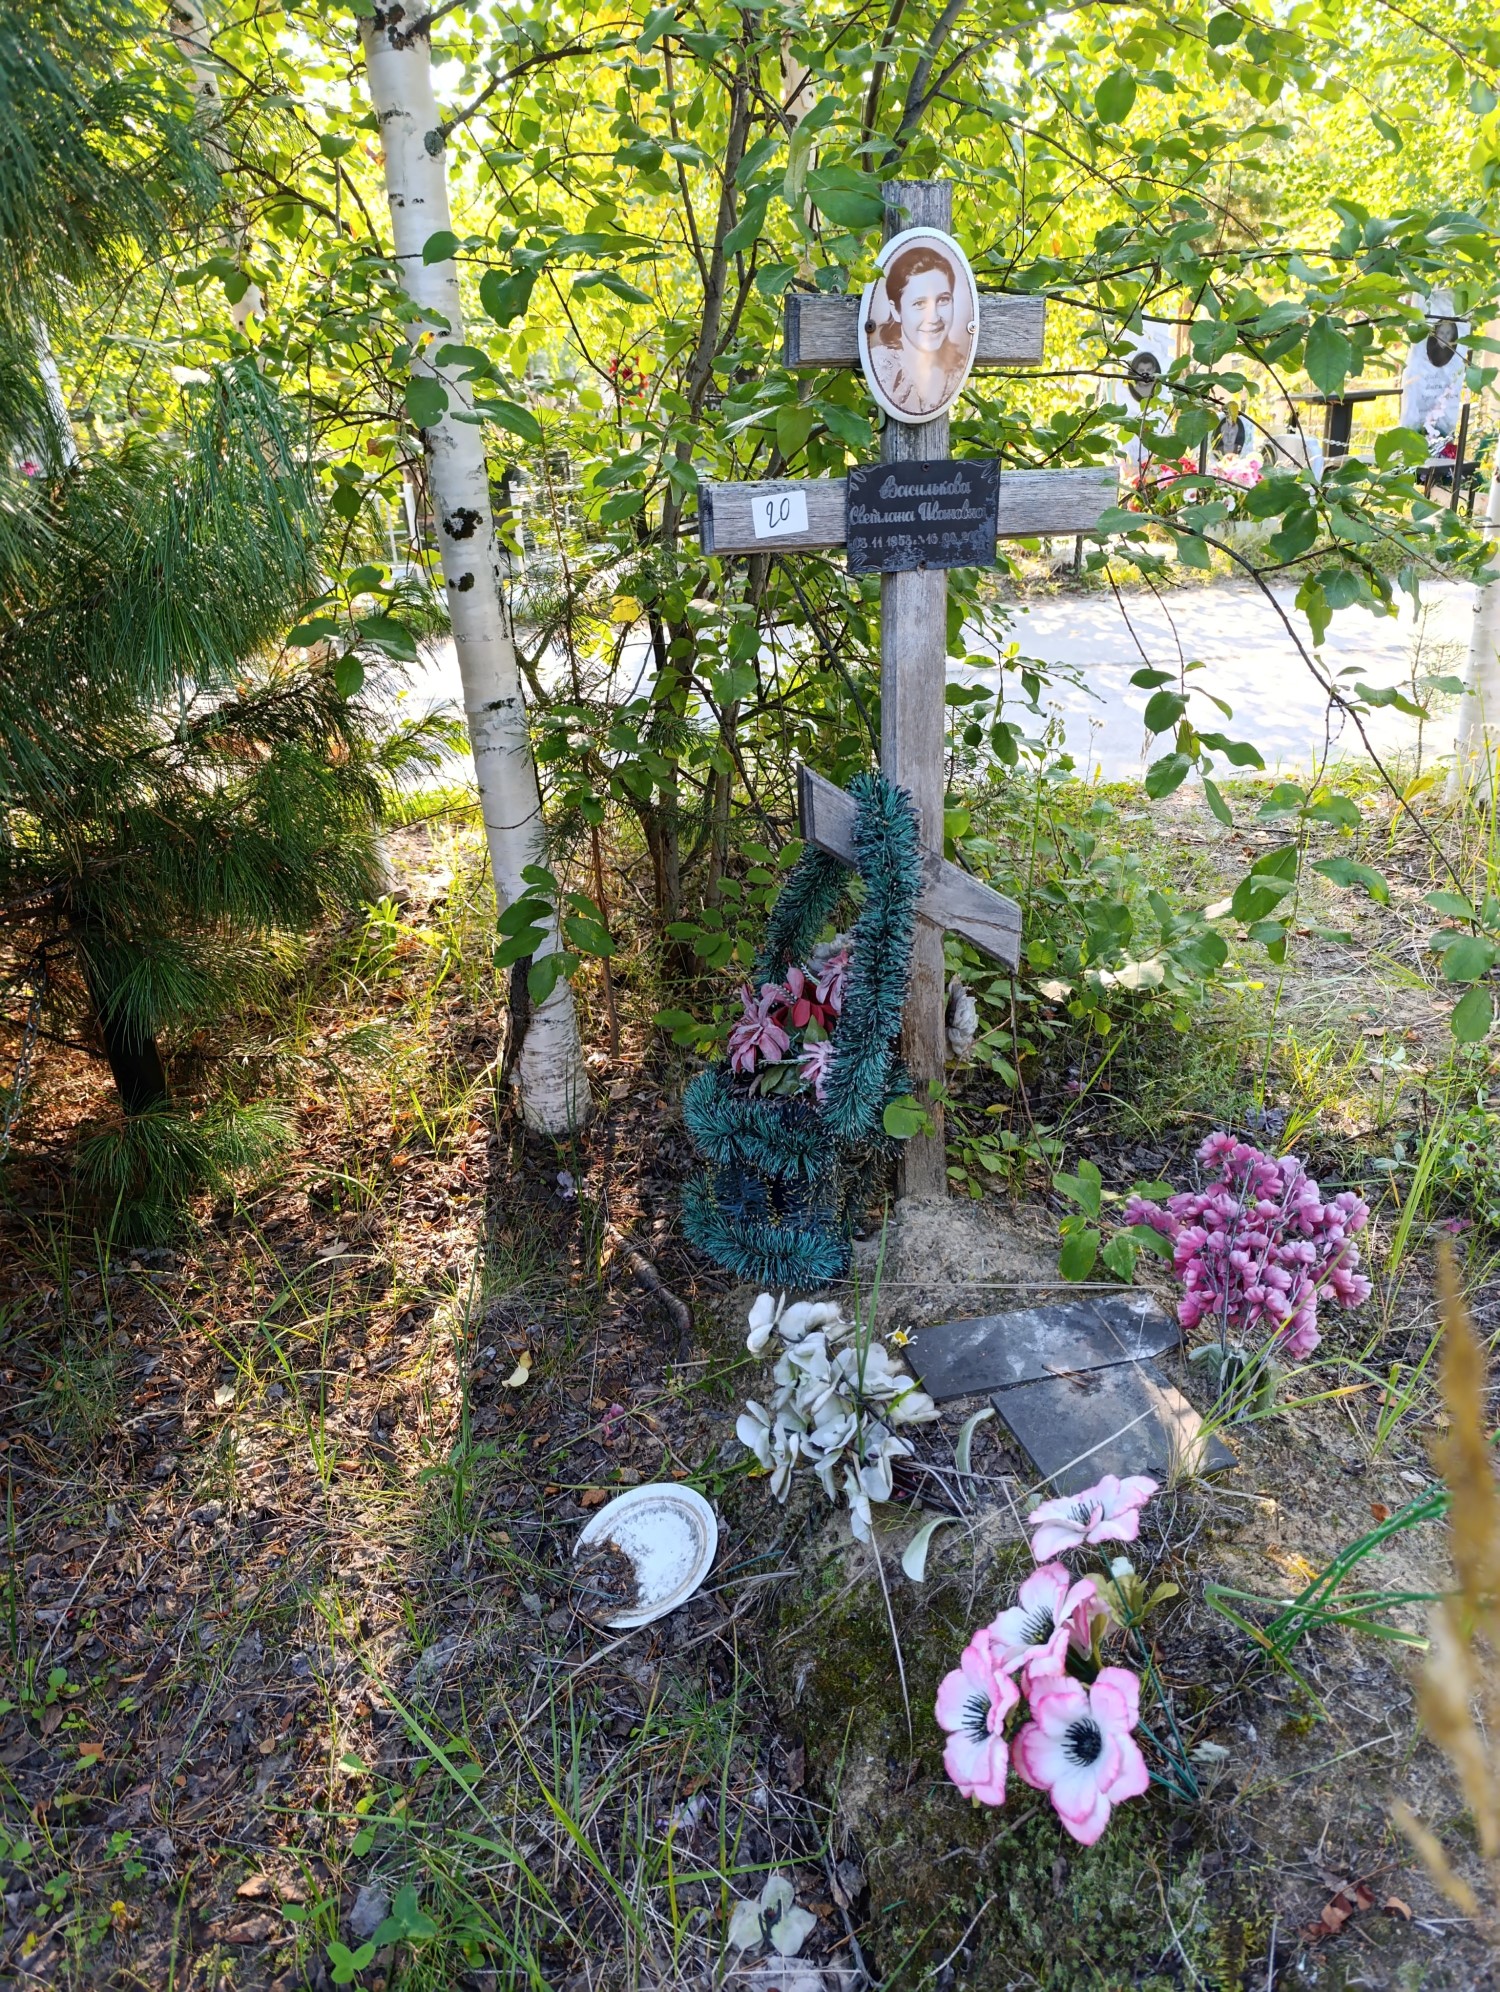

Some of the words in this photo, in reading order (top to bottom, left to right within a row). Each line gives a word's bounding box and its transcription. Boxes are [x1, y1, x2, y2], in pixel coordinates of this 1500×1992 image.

[878, 472, 972, 500] Василькова
[765, 497, 791, 529] 20
[849, 502, 915, 526] Светлана
[918, 498, 987, 522] Ивановна
